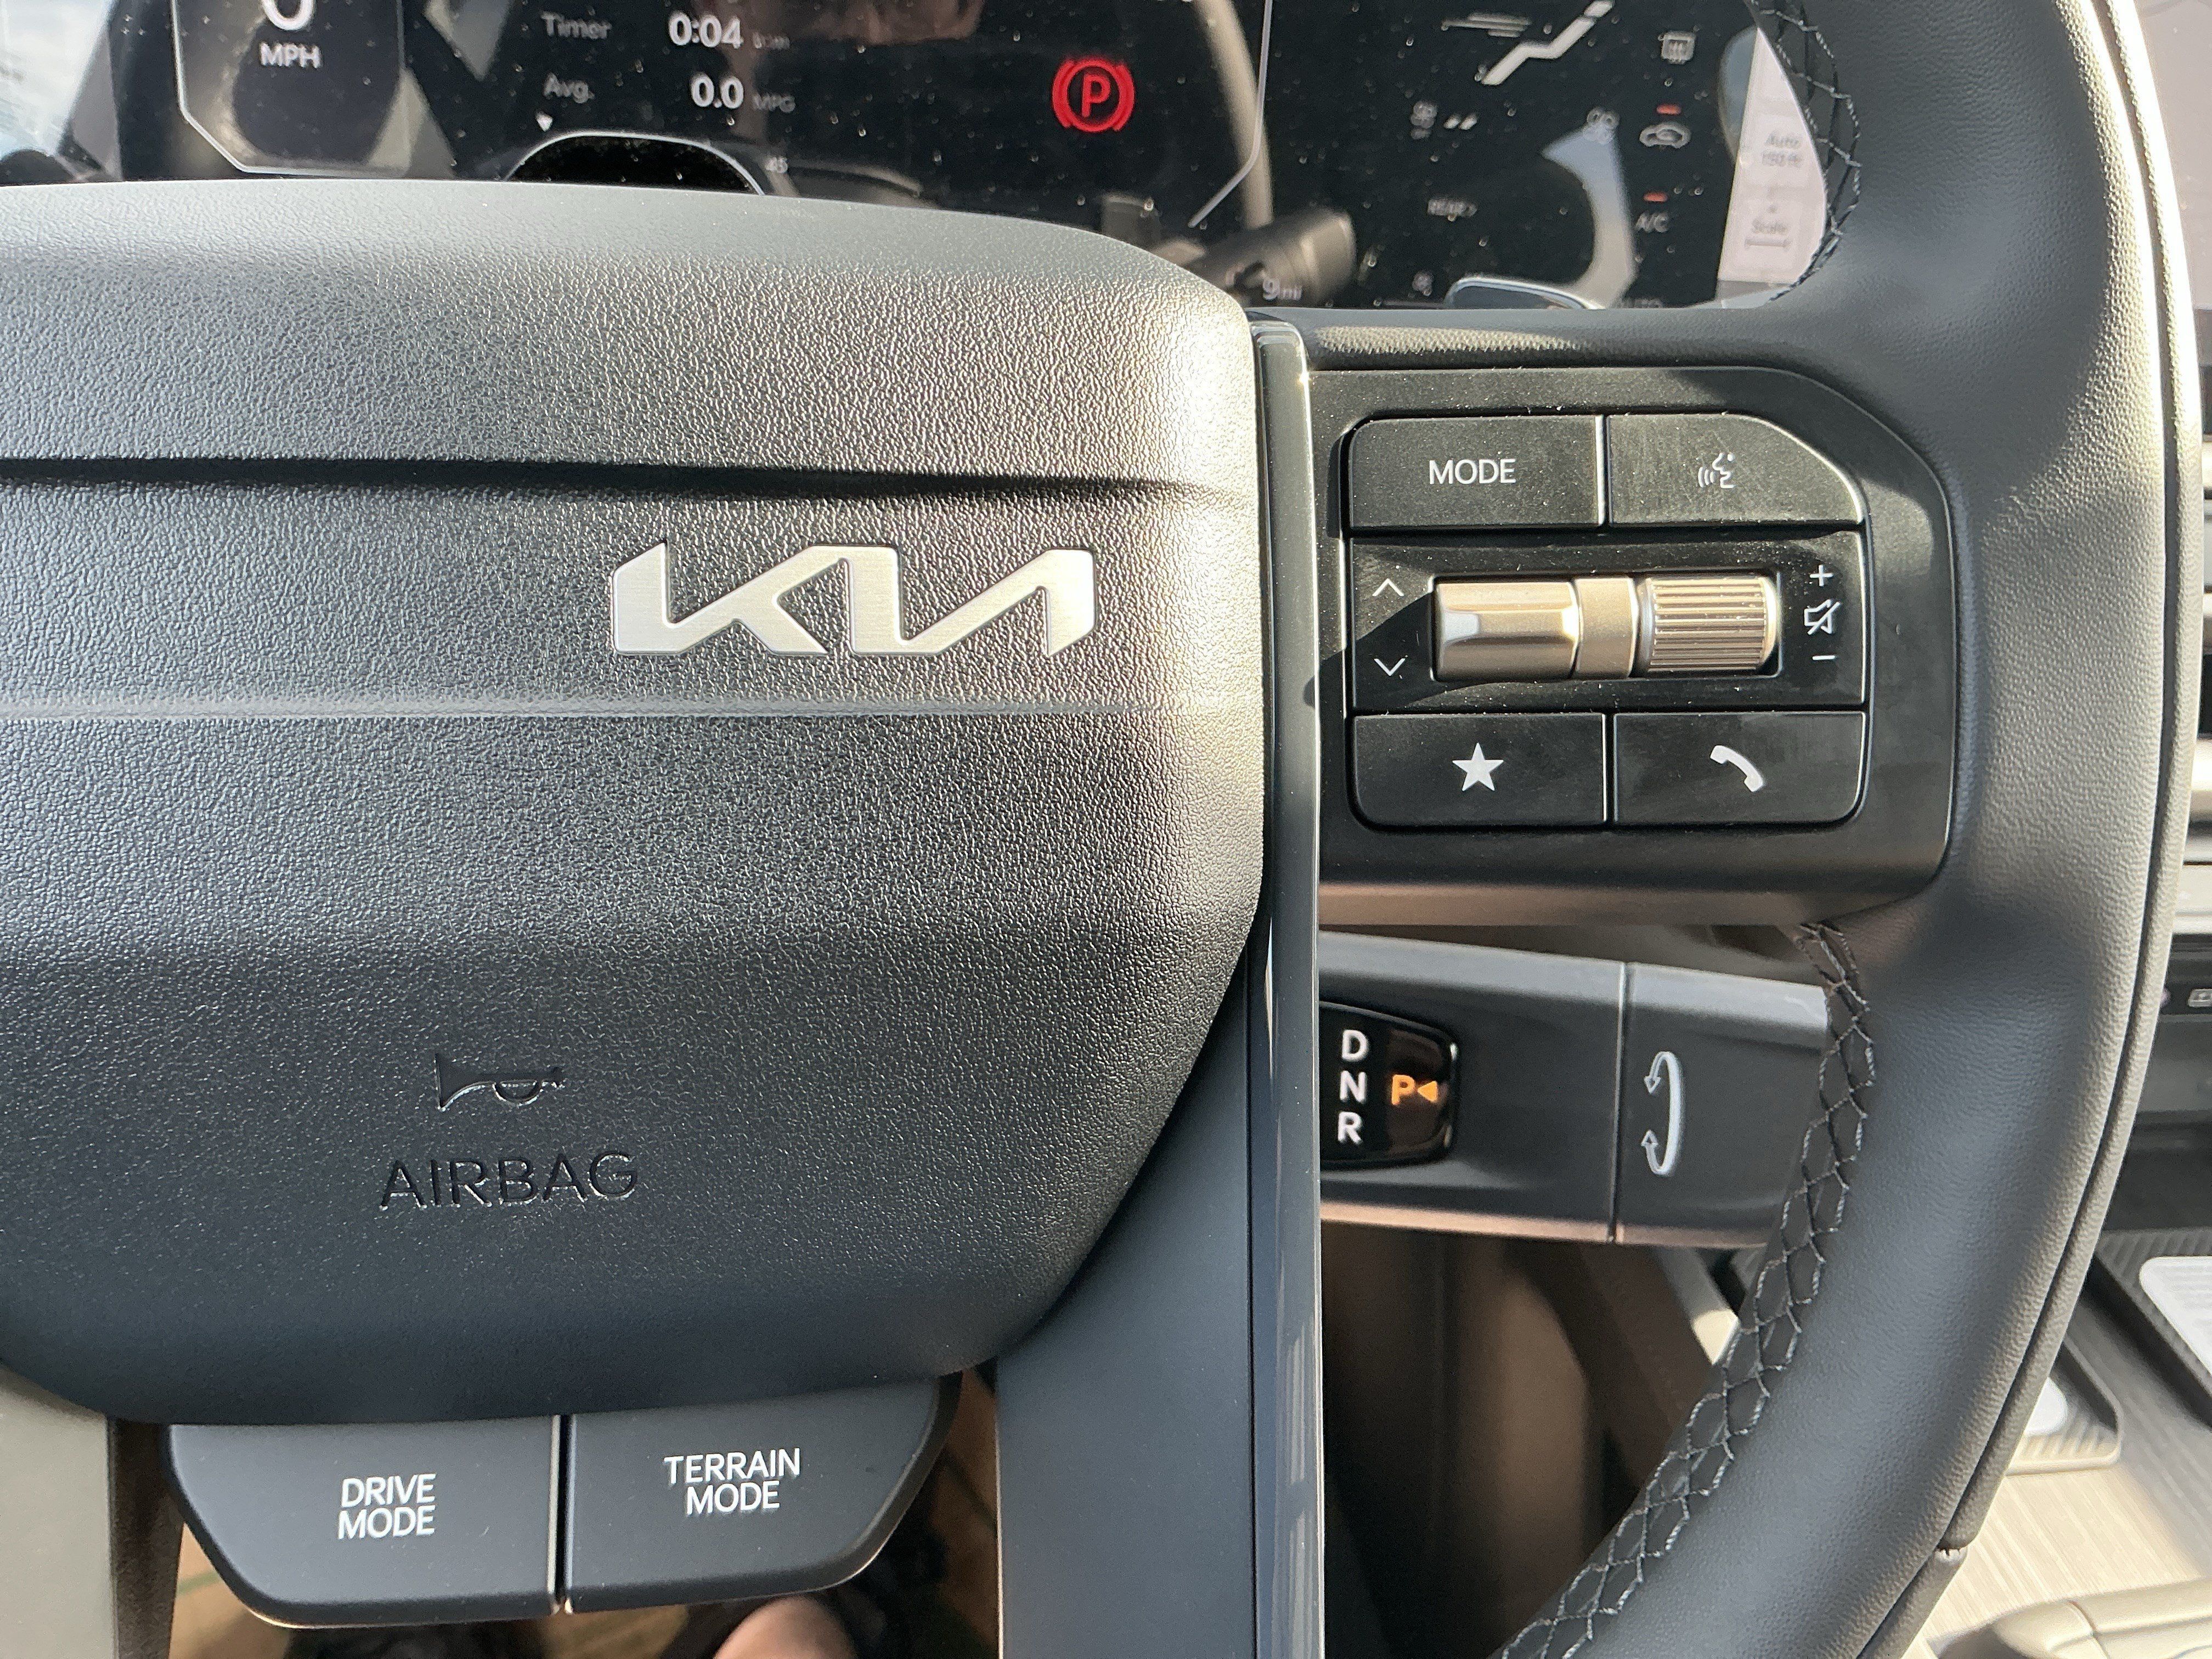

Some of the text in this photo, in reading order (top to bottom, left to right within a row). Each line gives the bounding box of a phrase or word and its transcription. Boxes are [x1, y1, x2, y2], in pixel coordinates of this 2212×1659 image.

[541, 11, 612, 39] Timer
[669, 10, 743, 49] 0:04
[259, 41, 321, 69] MPH
[690, 72, 744, 109] 0.0
[1634, 210, 1669, 233] A/C
[1429, 459, 1516, 484] MODE
[612, 543, 1095, 656] KIA
[1342, 1029, 1368, 1062] D
[1340, 1070, 1367, 1104] N
[1391, 1074, 1415, 1105] P
[1338, 1111, 1363, 1144] R
[381, 1152, 638, 1210] AIRBAG
[663, 1447, 800, 1484] TERRAIN
[341, 1472, 437, 1508] DRIVE
[686, 1480, 781, 1515] MODE
[338, 1504, 436, 1540] MODE
